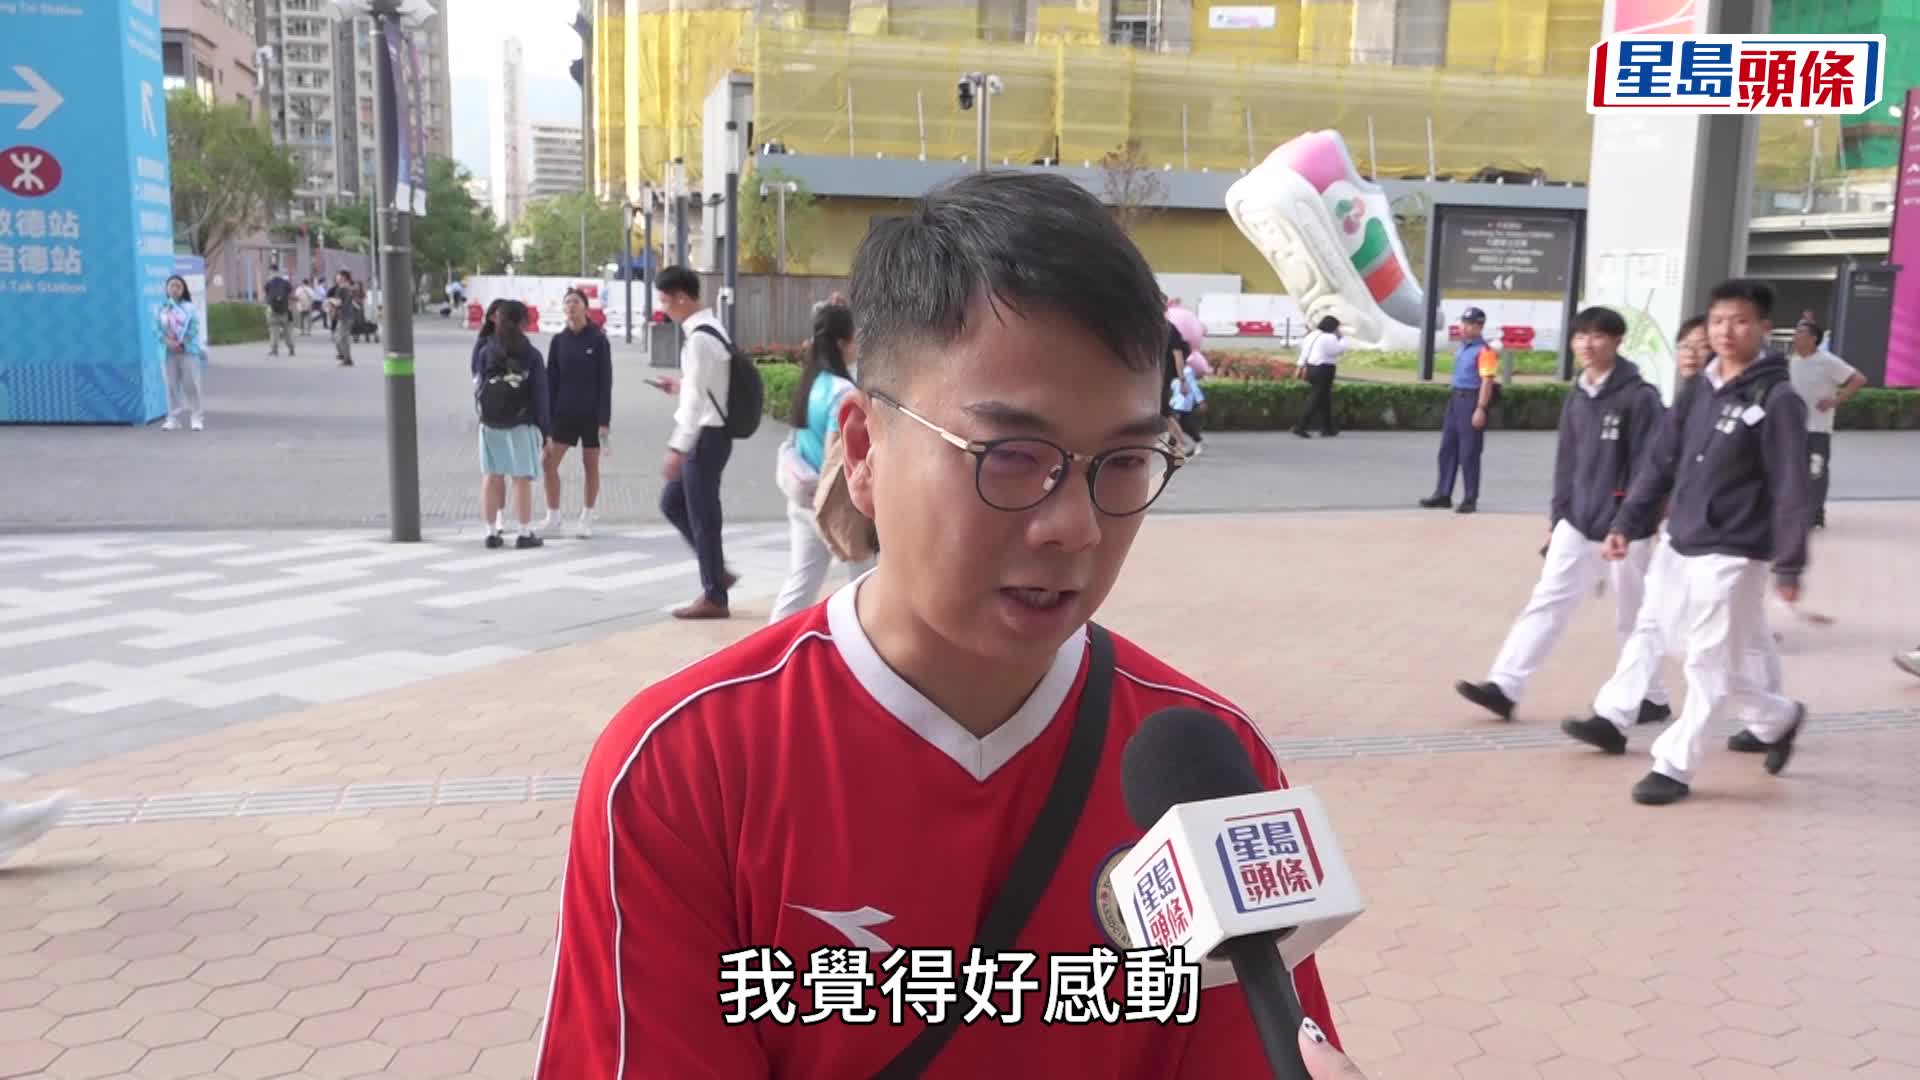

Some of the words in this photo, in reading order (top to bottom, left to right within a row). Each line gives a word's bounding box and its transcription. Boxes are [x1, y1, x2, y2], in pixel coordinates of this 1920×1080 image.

[1228, 821, 1300, 862] 星島
[1137, 858, 1177, 917] 星島
[1239, 858, 1313, 904] 頭條
